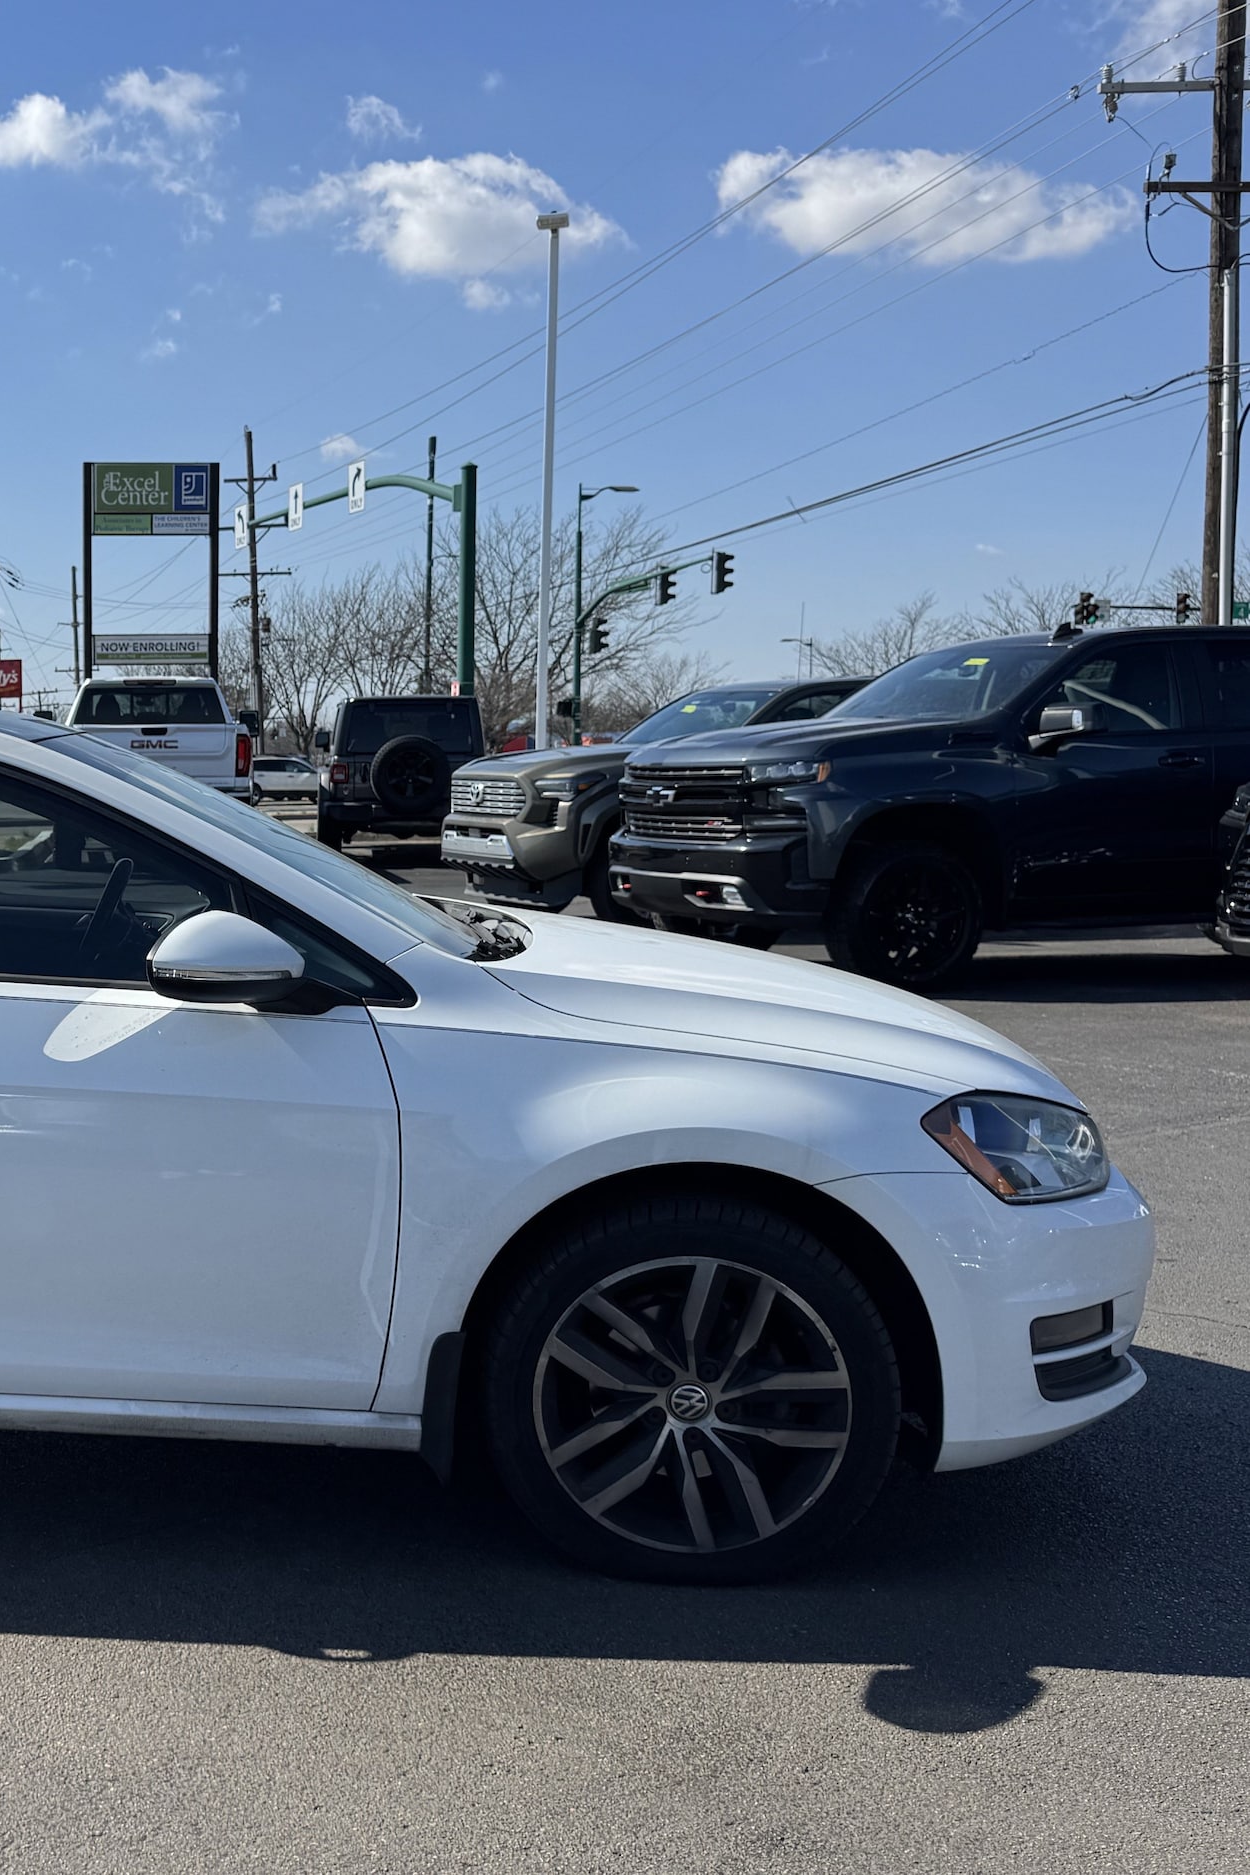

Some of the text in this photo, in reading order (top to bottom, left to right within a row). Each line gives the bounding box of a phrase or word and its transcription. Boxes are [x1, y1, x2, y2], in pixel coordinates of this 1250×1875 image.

[108, 471, 161, 491] Excel
[101, 487, 169, 505] Center
[100, 641, 200, 652] NOW ENROLLING!
[131, 740, 179, 749] GMC
